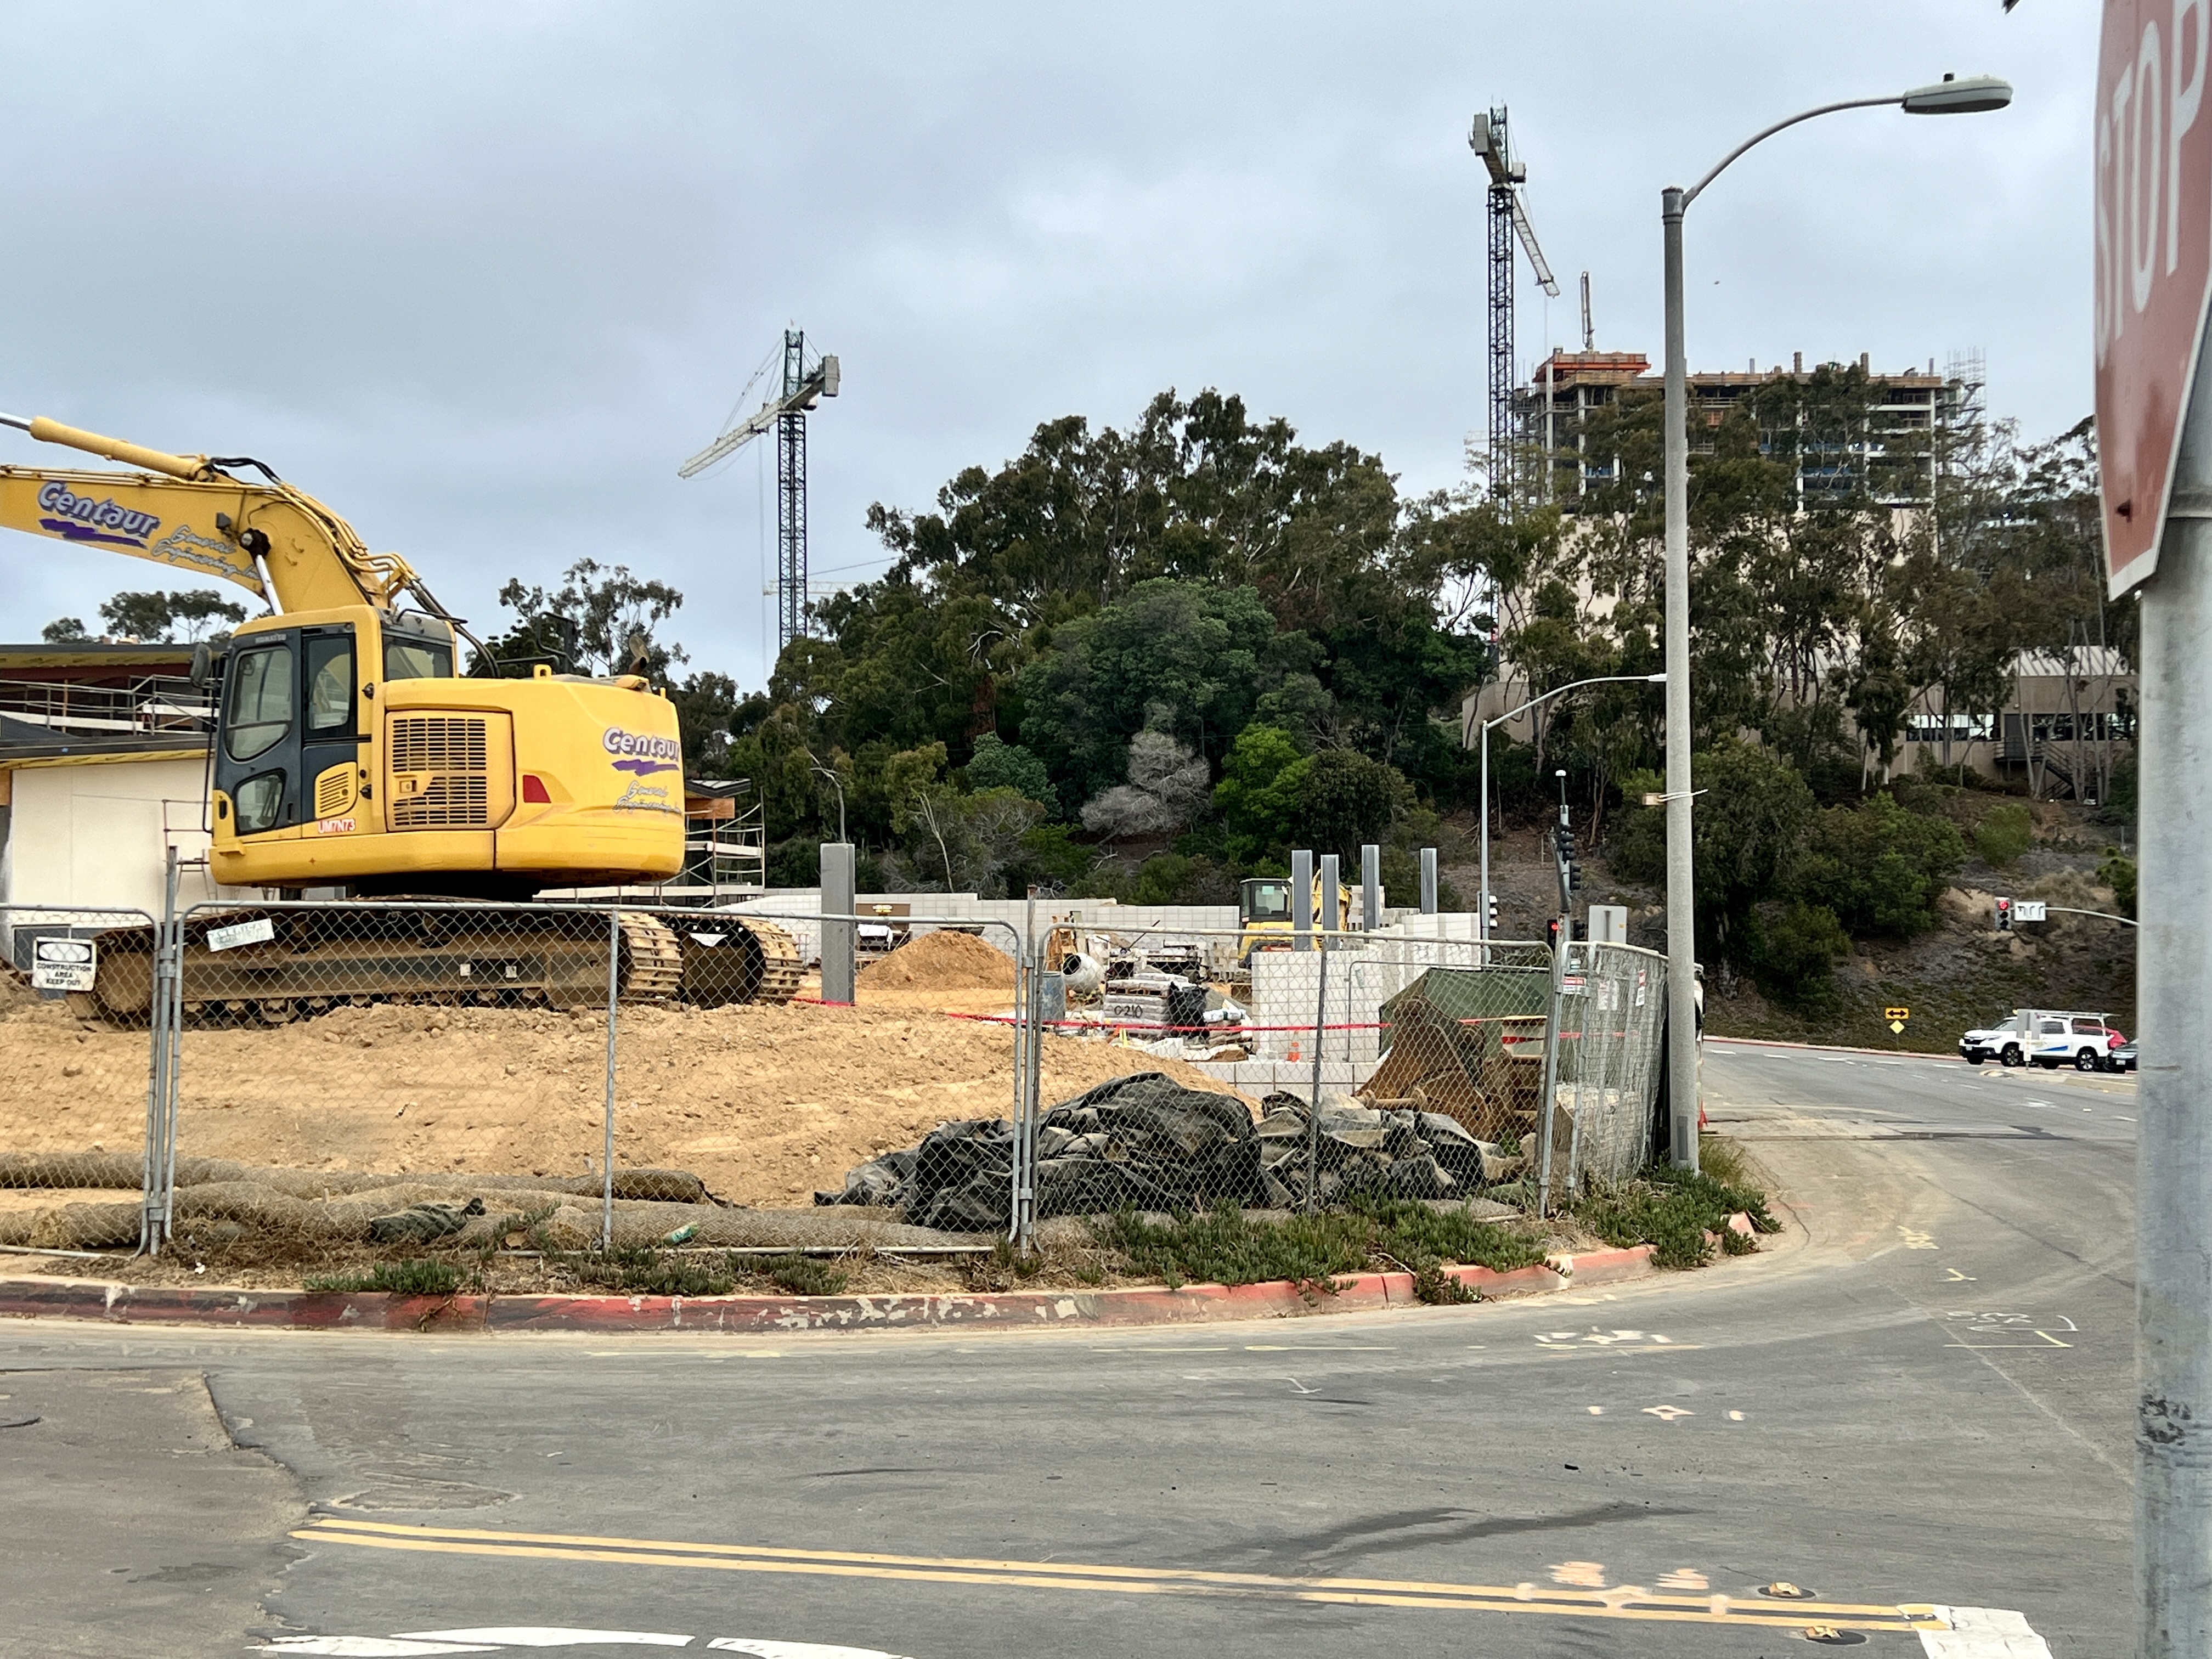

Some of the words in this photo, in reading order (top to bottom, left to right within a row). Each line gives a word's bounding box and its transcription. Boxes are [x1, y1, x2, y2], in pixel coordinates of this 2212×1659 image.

[2095, 0, 2210, 370] STOP
[38, 481, 161, 539] Centaur
[171, 524, 236, 554] General
[602, 727, 680, 761] Centaur
[36, 962, 92, 972] CONSTRUCTION
